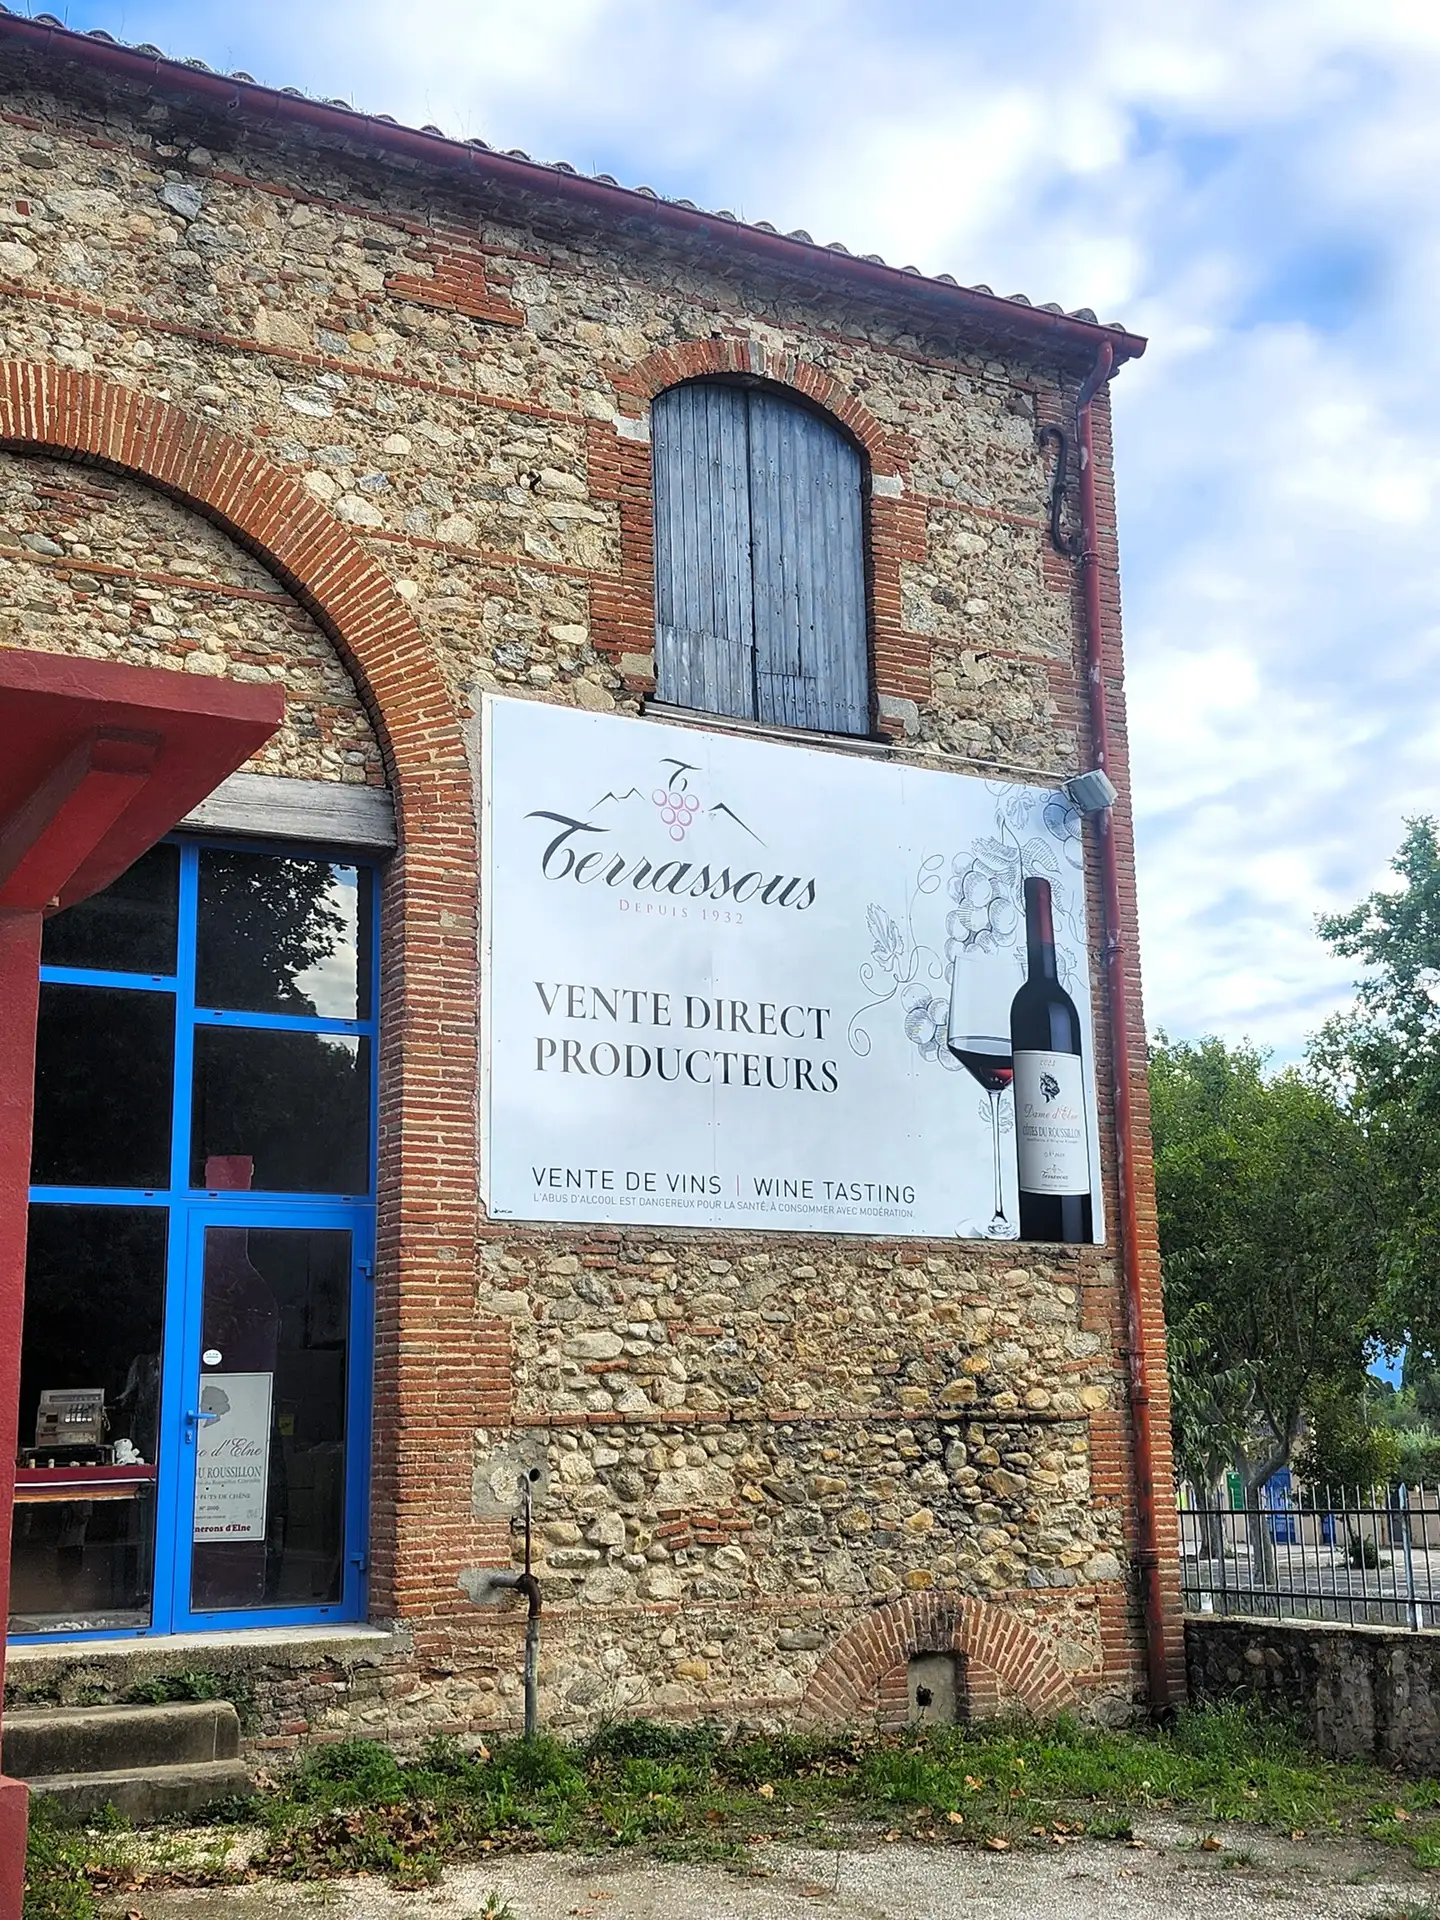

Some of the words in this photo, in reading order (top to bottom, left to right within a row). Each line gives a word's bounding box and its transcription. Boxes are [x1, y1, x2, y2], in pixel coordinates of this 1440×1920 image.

[523, 811, 816, 910] Terrassous
[619, 899, 688, 918] DEPUIS
[702, 909, 743, 924] 1932
[533, 981, 671, 1026] VENTE
[684, 995, 831, 1040] DIRECT
[533, 1037, 838, 1093] PRODUCTEURS
[532, 1166, 614, 1190] VENTE
[626, 1171, 657, 1192] DE
[666, 1173, 722, 1195] VINS
[754, 1177, 814, 1199] WINE
[822, 1181, 915, 1204] TASTING
[533, 1193, 568, 1203] L'ABUS
[571, 1194, 617, 1206] D'ALCOOL
[619, 1197, 636, 1206] EST
[639, 1198, 695, 1209] DANGEREUX
[697, 1200, 722, 1210] POUR
[724, 1201, 736, 1210] LA
[778, 1203, 835, 1215] CONSOMMER
[836, 1207, 858, 1216] AVEC
[207, 1466, 261, 1478] ROUSSILLON
[194, 1525, 224, 1533] nerons
